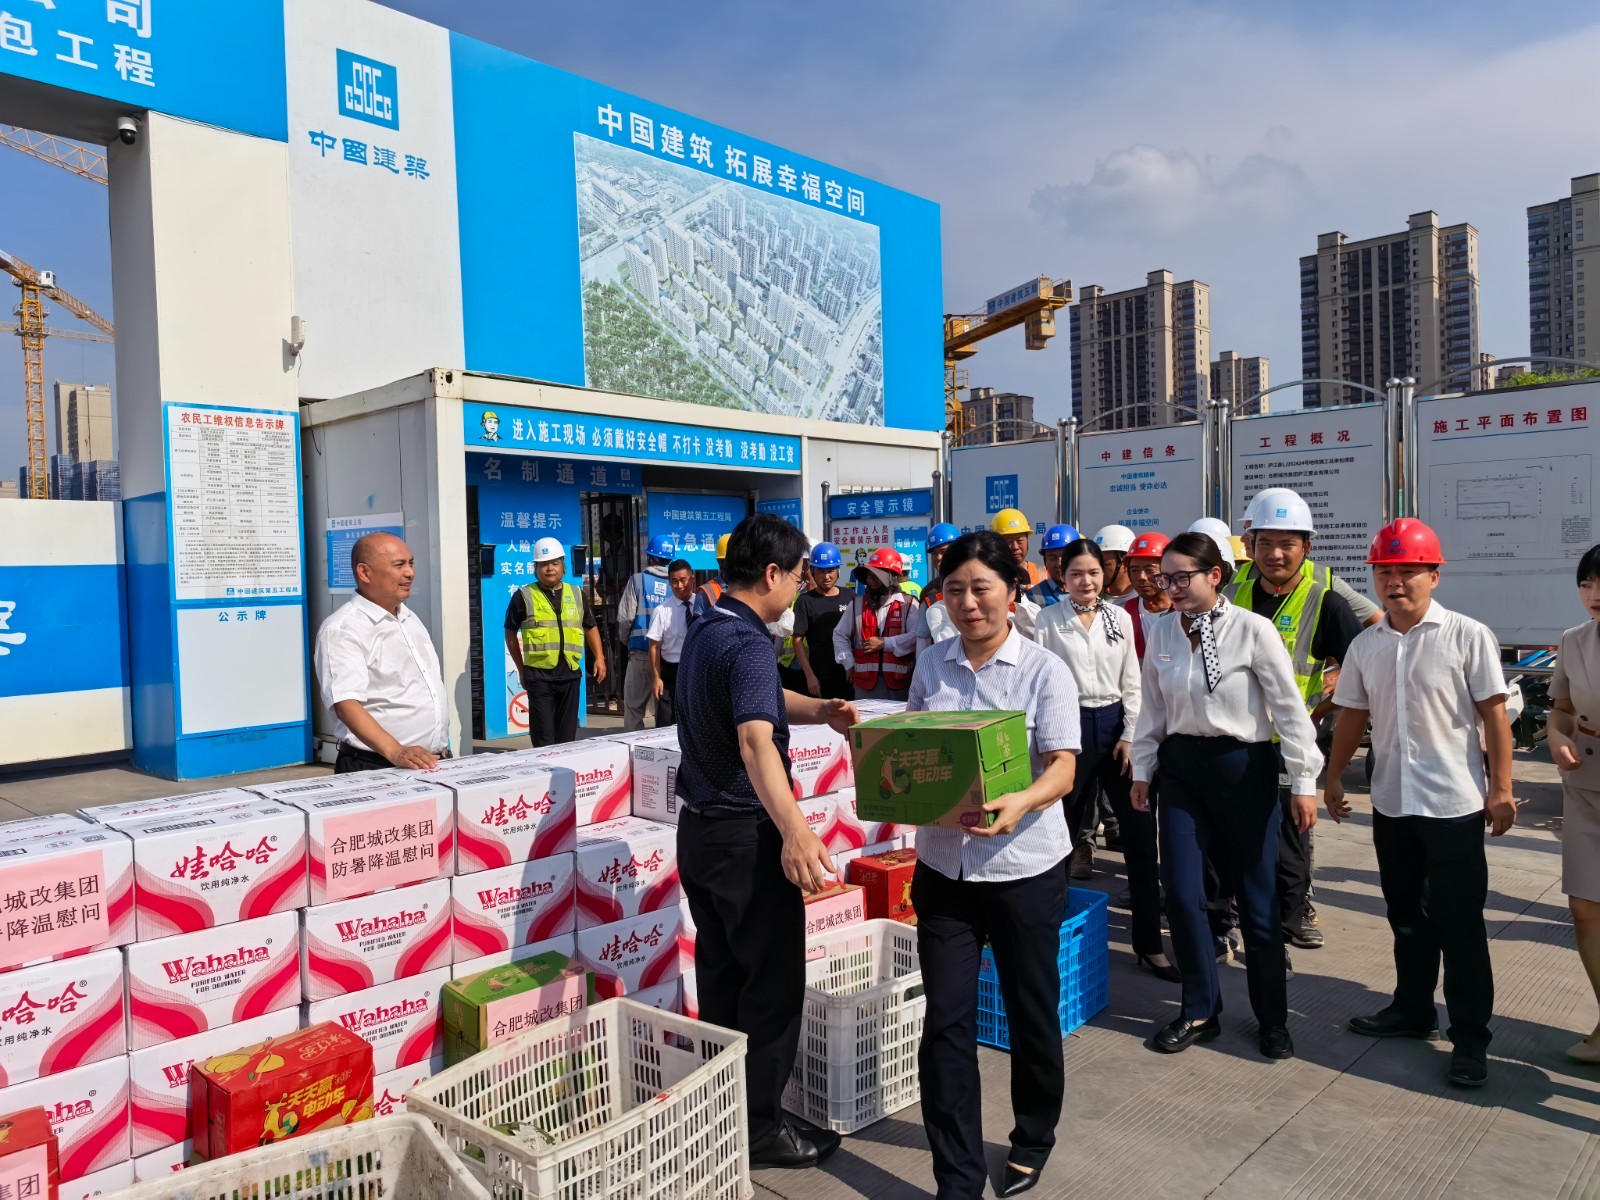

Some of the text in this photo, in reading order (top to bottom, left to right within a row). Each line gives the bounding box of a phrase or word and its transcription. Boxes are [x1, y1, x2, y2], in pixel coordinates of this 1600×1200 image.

[0, 10, 156, 87] 包工程
[597, 103, 865, 217] 中国建筑 拓展幸福空间
[181, 412, 285, 430] 农民工维权信息告示牌
[1433, 406, 1588, 434] 施工平面布置图
[512, 418, 794, 463] 进入施工现场 必须戴好安全帽 不打卡 没考勤 没考勤 没工资
[1259, 430, 1351, 448] 工程概况
[1101, 445, 1176, 462] 中建信条
[1139, 481, 1168, 490] 使命必达
[664, 509, 732, 522] 中国建筑第五工程局
[847, 497, 914, 515] 安全警示镜
[500, 511, 562, 529] 温馨提示
[834, 525, 889, 535] 施工作业人员
[834, 535, 889, 545] 安全着装示意图
[218, 610, 267, 622] 公示牌
[899, 748, 940, 767] 天天赢
[913, 766, 953, 784] 电动车
[481, 791, 556, 826] 娃哈哈
[330, 819, 434, 855] 合肥城改集团
[503, 823, 537, 835] 饮用纯净水
[170, 836, 277, 880] 娃哈哈
[331, 843, 434, 879] 防暑降温慰问
[598, 850, 663, 884] 娃哈哈
[0, 875, 99, 915] 城改集团
[200, 875, 249, 891] 饮用纯净水
[477, 881, 554, 910] Wahaha
[0, 903, 101, 941] 降温慰问
[335, 910, 427, 942] Wahaha
[806, 905, 862, 934] 合肥城改集团
[359, 931, 406, 947] PURIFIED WATER
[377, 939, 402, 949] DRINKING
[599, 923, 664, 961] 娃哈哈
[161, 946, 270, 984] Wahaha
[616, 955, 646, 969] 饮用纯净水
[191, 970, 246, 988] PURIFIED WATER
[196, 978, 242, 994] FOR DRINKING
[0, 981, 87, 1030] 哈哈
[339, 998, 428, 1031] Wahaha
[493, 995, 583, 1038] 合肥城改集团
[0, 1026, 52, 1046] 用纯净水
[390, 1020, 407, 1029] WATER
[287, 1074, 334, 1110] 天天赢
[303, 1085, 346, 1119] 电动车
